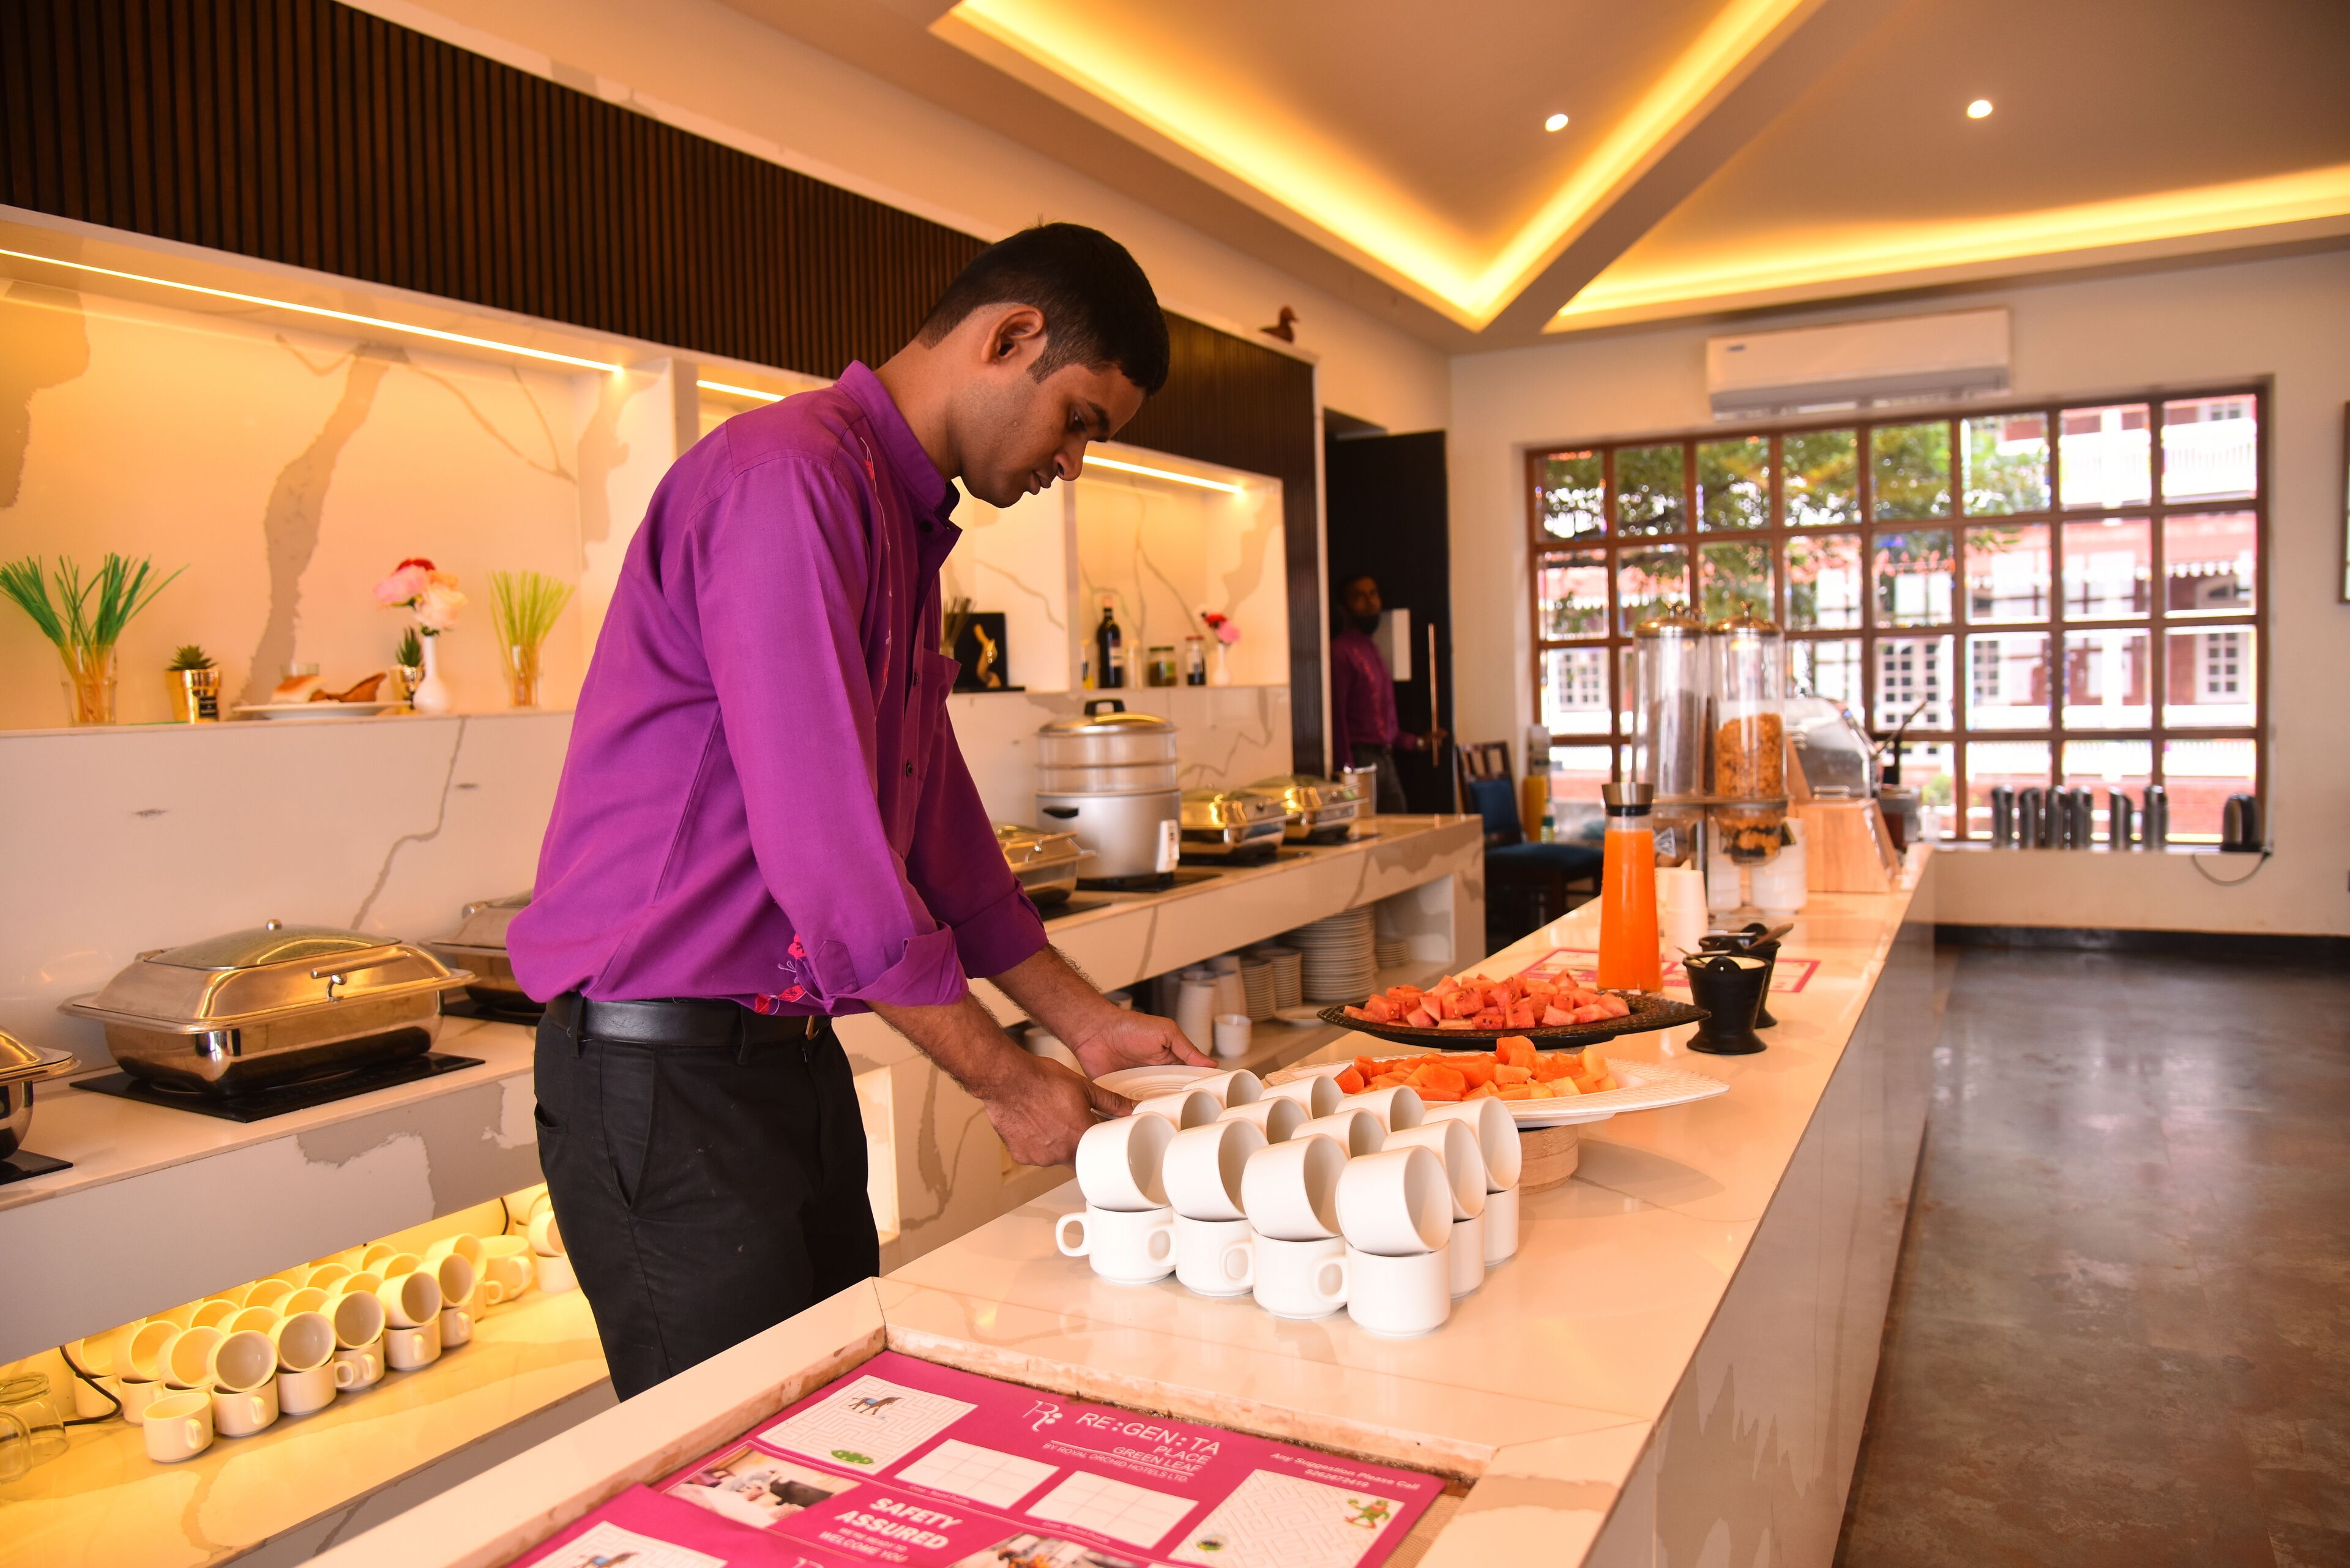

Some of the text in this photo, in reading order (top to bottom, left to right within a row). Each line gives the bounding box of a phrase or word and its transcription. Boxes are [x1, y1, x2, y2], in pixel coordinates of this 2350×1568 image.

[1057, 1446, 1087, 1458] ROYAL
[1089, 1453, 1127, 1468] ORCHID
[1128, 1462, 1168, 1479] HOTELS
[1113, 1446, 1202, 1472] GREEN LEAF
[1153, 1445, 1212, 1465] PLACE
[1270, 1452, 1421, 1490] Any Suggestion Please Call
[869, 1498, 963, 1529] SAFETY
[834, 1510, 949, 1550] ASSURED
[838, 1527, 908, 1552] WE'RE READY TO
[818, 1531, 909, 1562] WELCOME YOU
